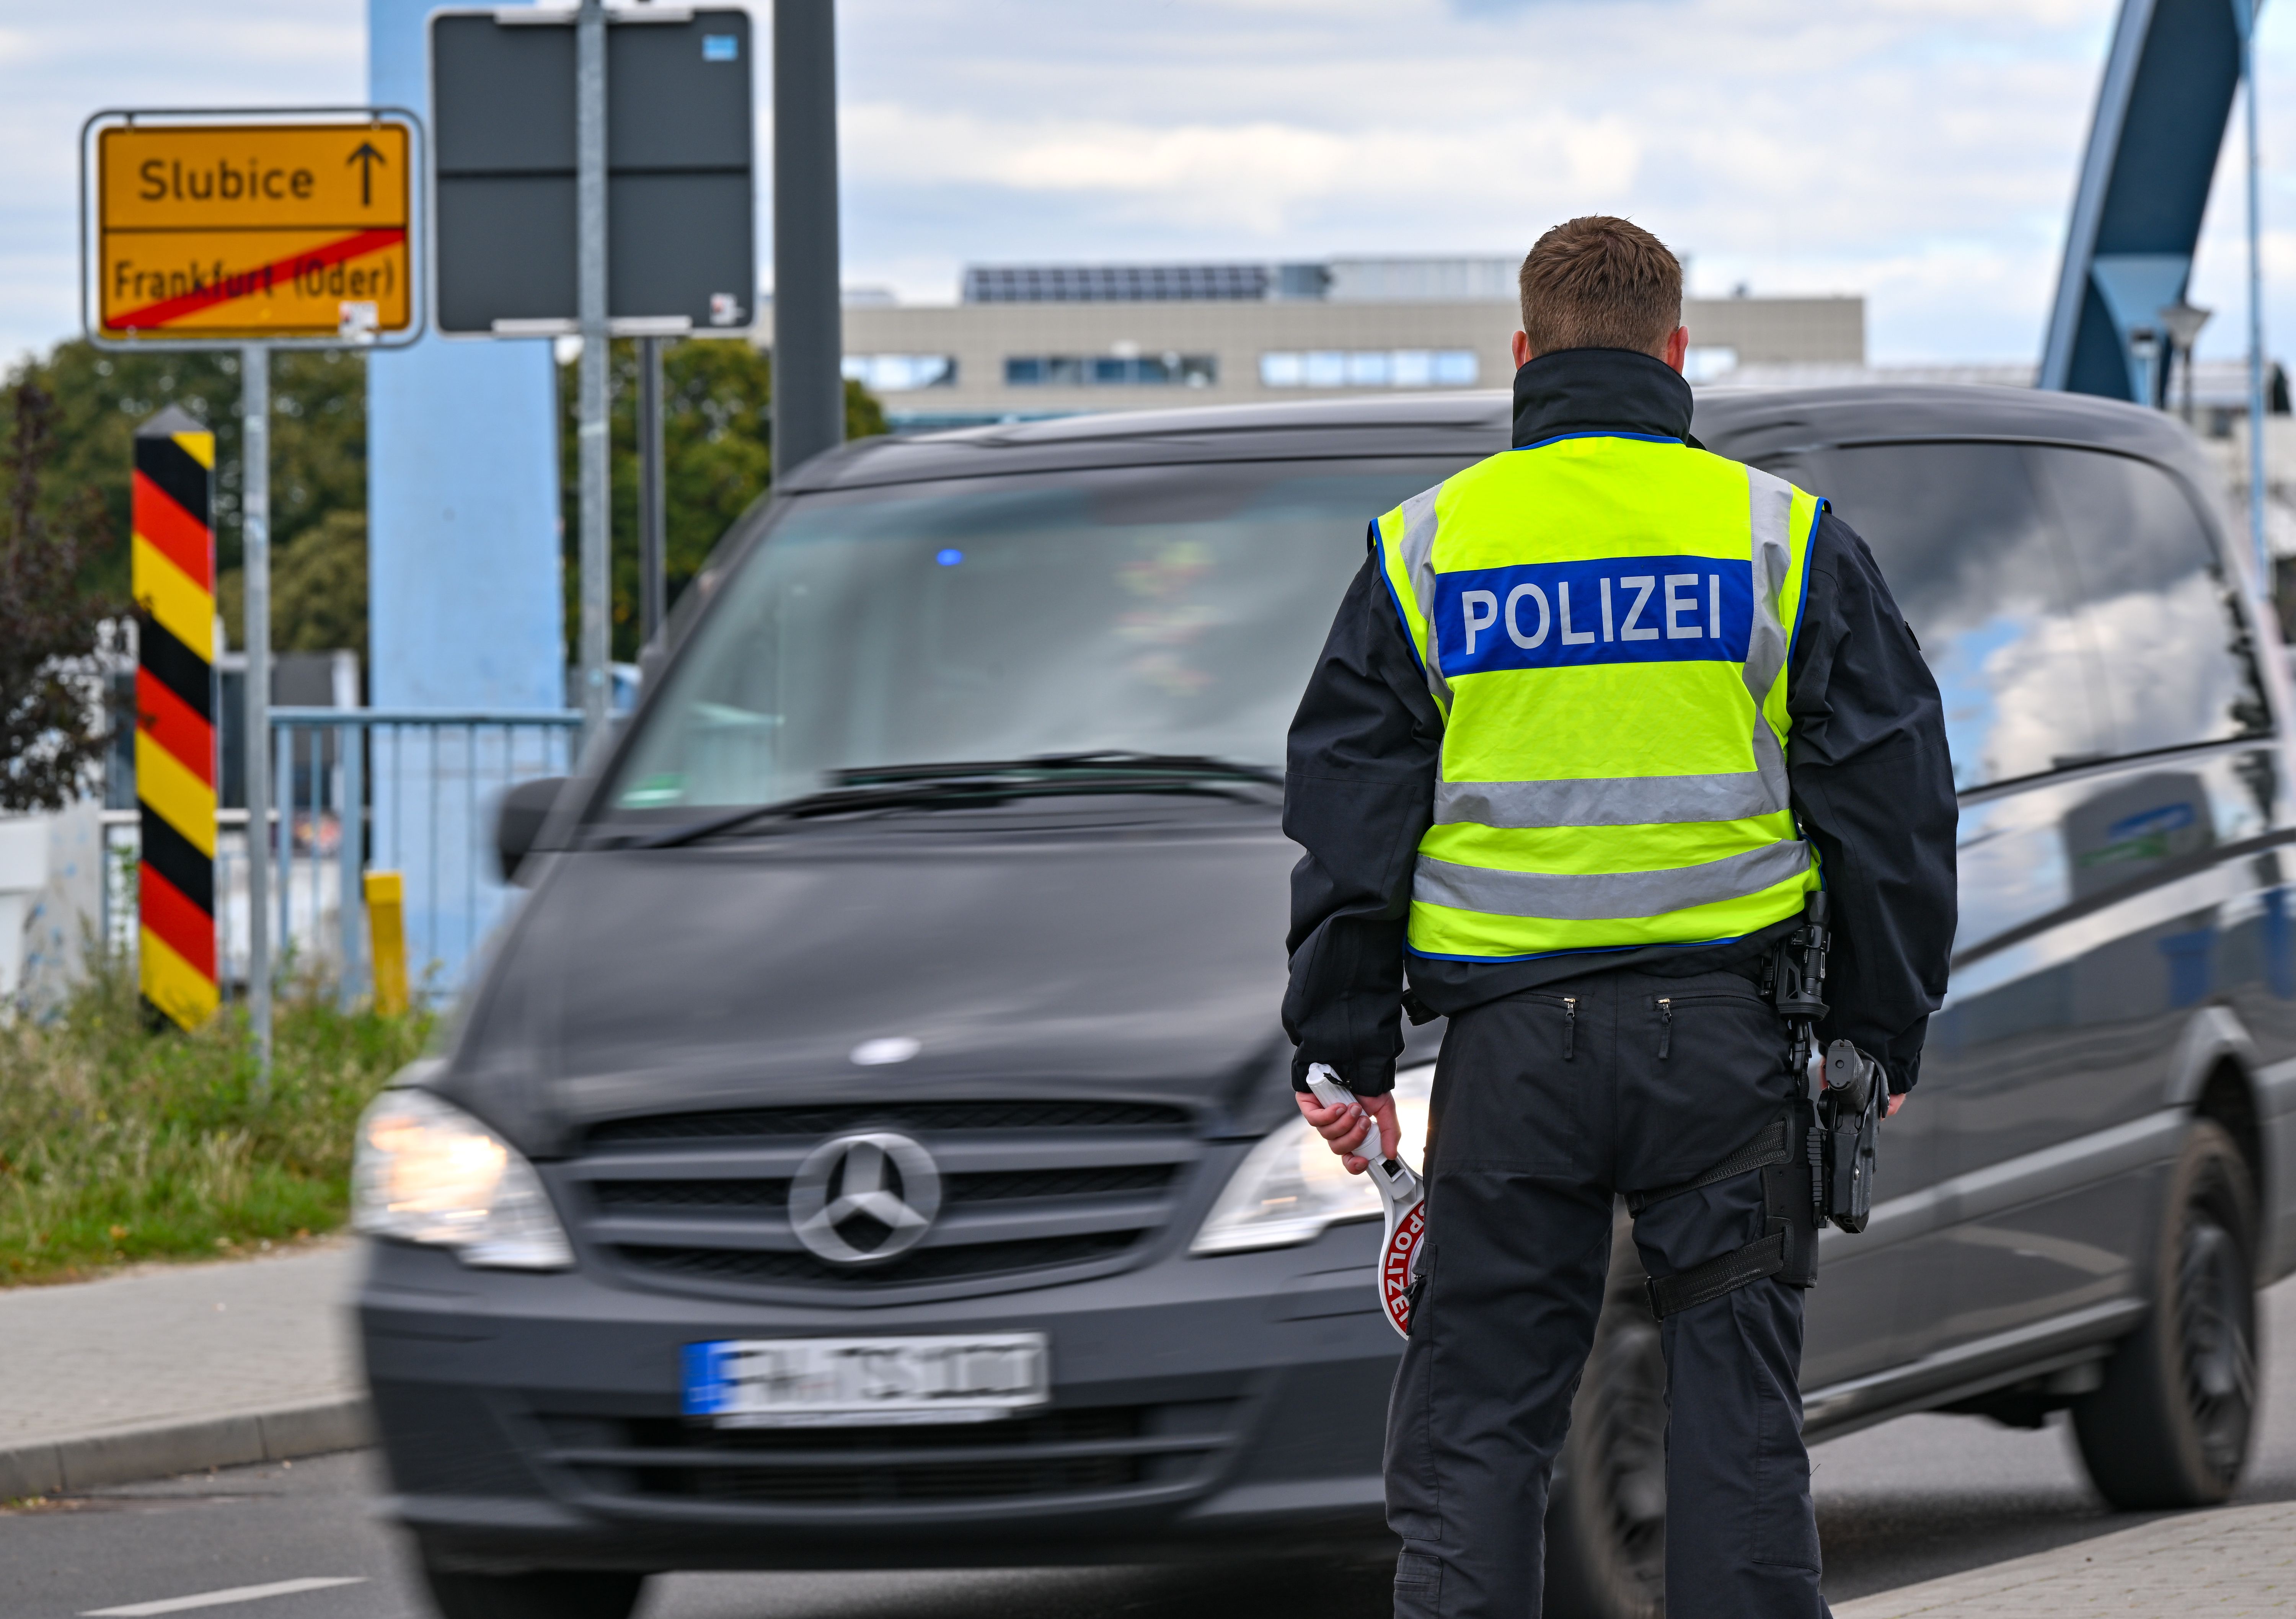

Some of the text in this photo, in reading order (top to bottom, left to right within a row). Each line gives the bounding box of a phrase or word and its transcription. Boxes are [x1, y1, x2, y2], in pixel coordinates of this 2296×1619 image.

[139, 158, 314, 201] Slubice
[116, 256, 394, 300] Frankfurt (Oder)
[1462, 574, 1720, 655] POLIZEI
